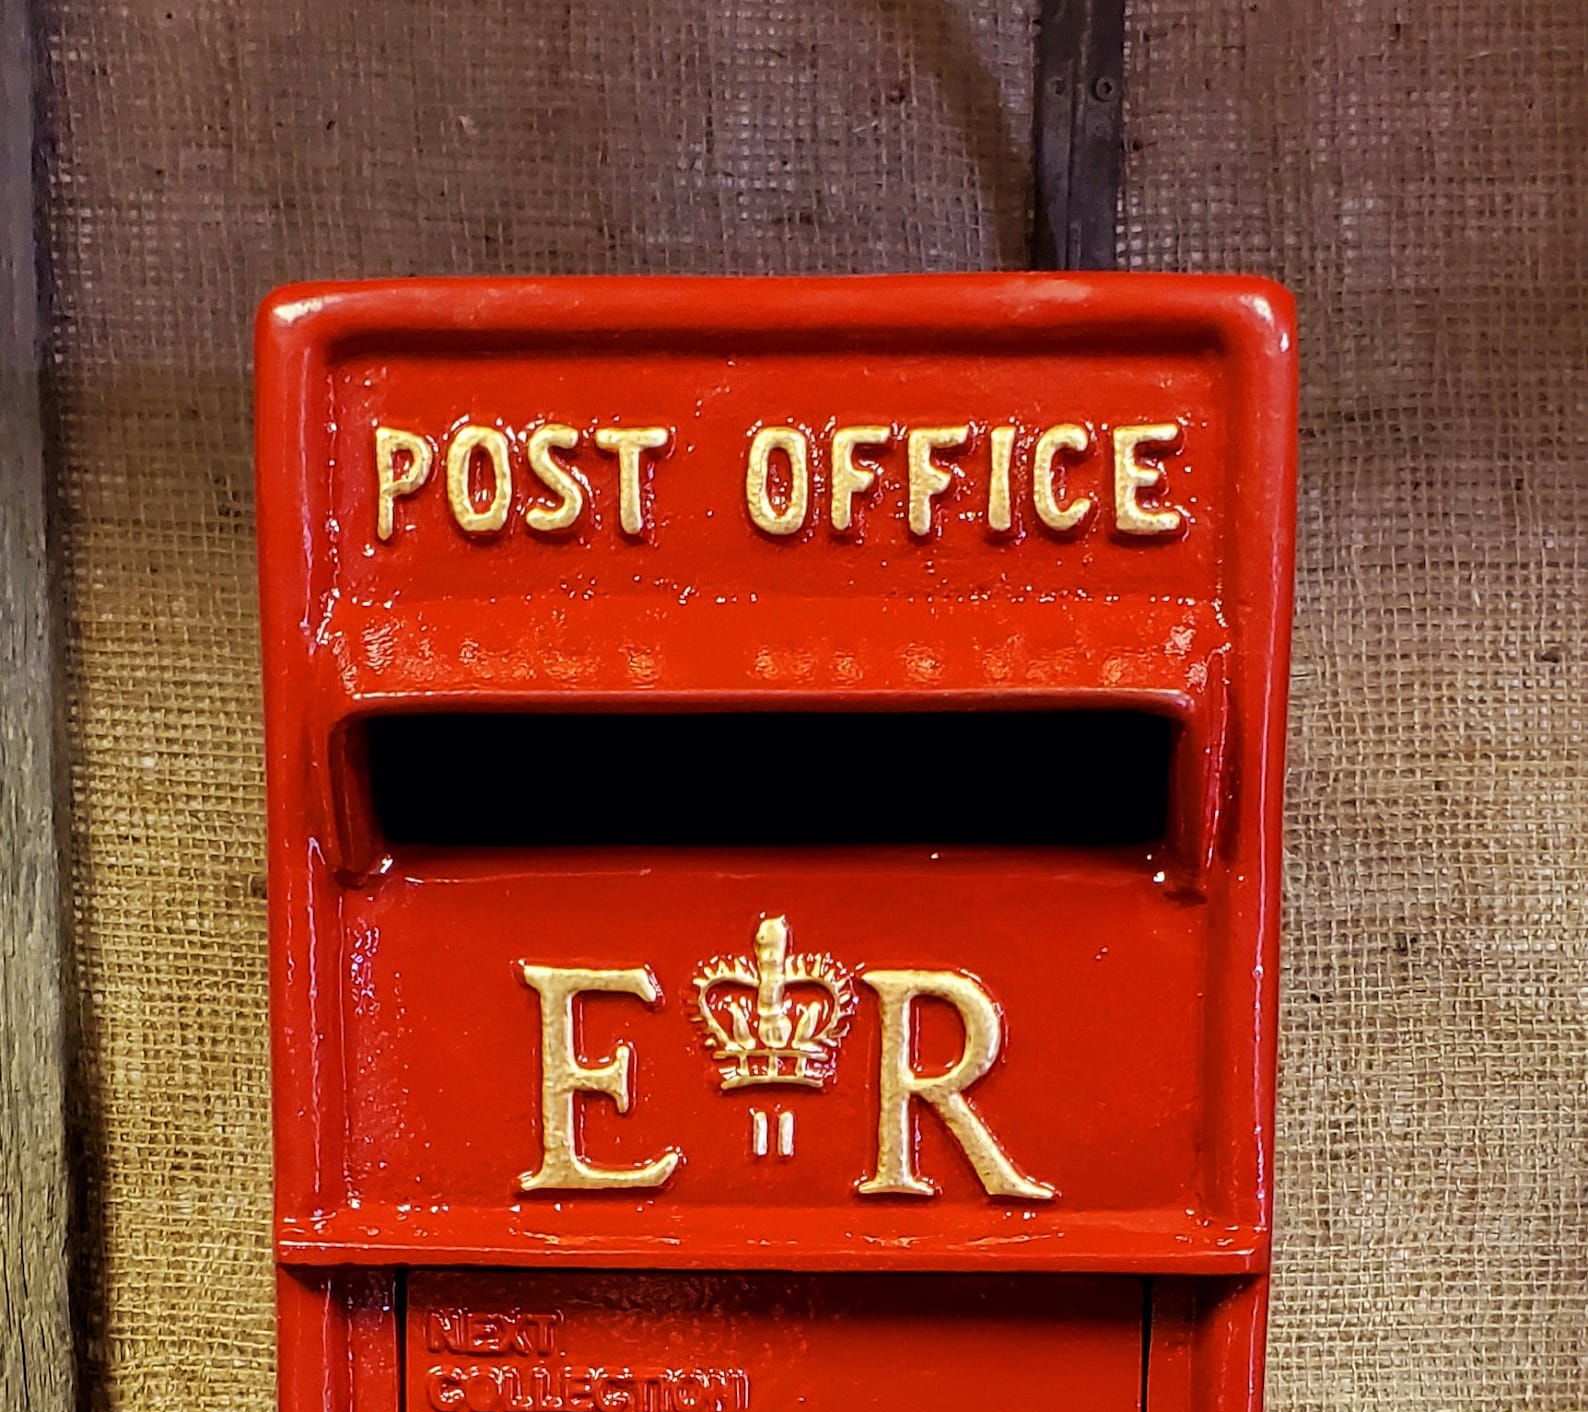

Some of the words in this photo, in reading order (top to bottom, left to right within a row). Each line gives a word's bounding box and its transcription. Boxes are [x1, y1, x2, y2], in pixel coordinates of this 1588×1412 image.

[374, 424, 670, 541] POST
[746, 423, 1183, 536] OFFICE
[519, 964, 683, 1191] E
[856, 968, 1058, 1199] R
[426, 1307, 564, 1354] NEXT
